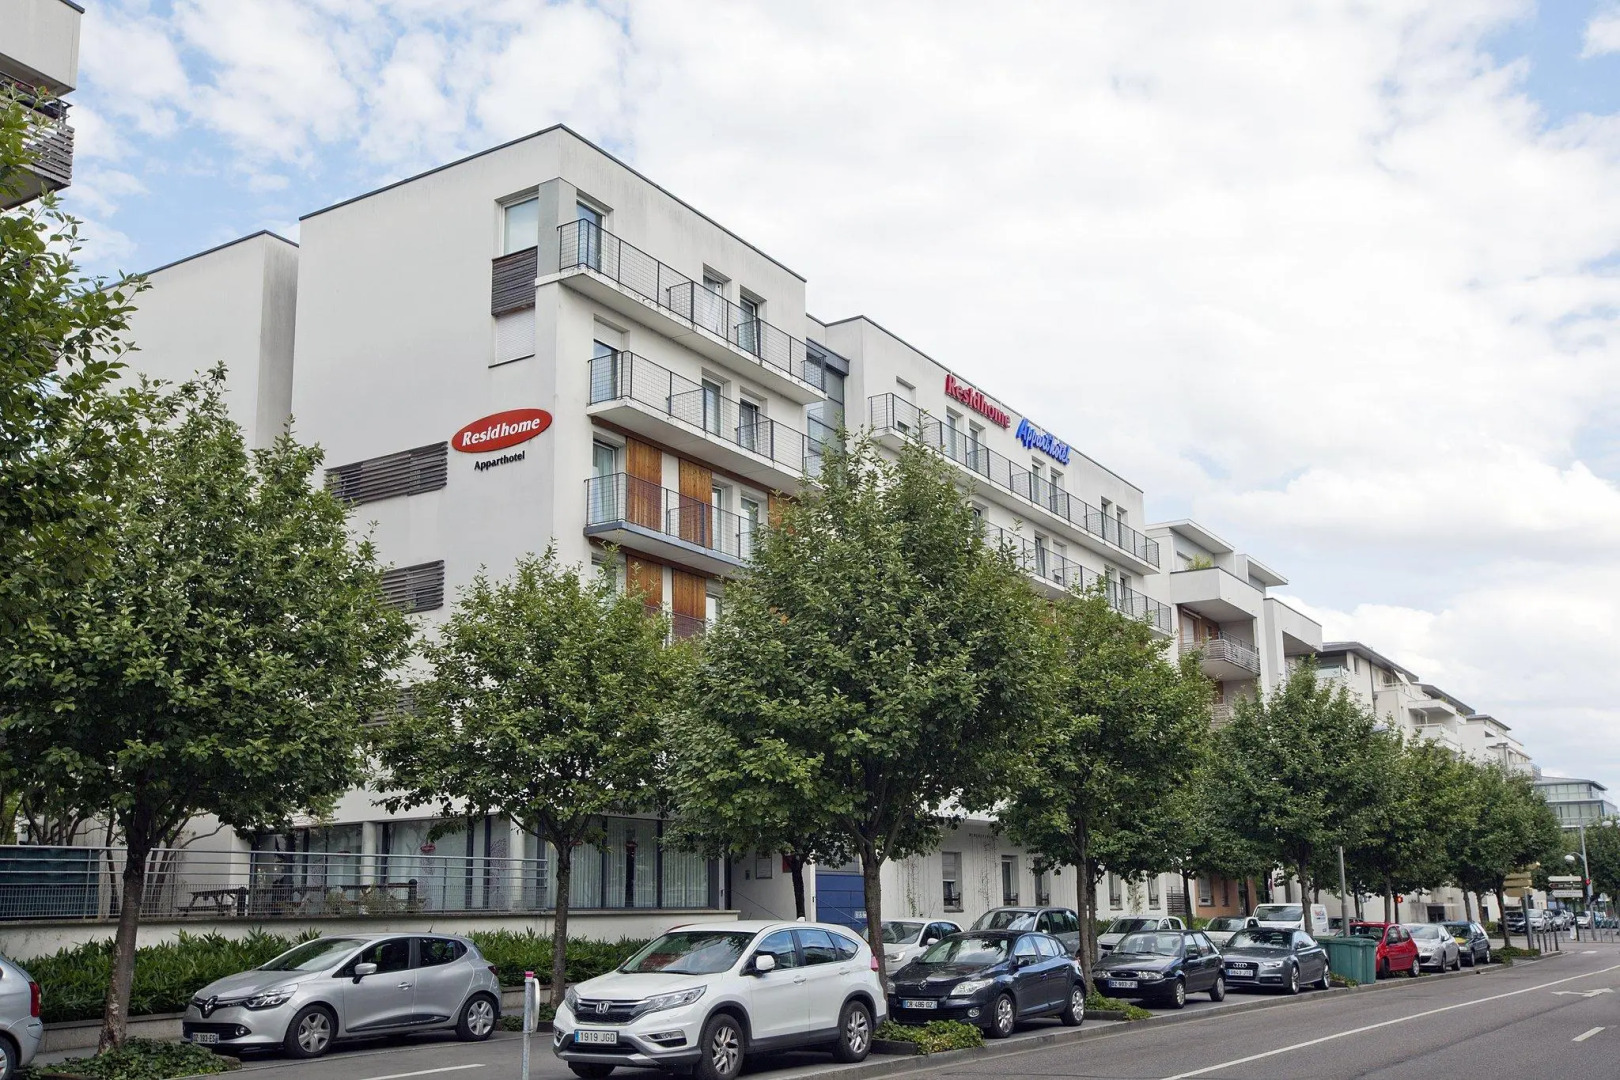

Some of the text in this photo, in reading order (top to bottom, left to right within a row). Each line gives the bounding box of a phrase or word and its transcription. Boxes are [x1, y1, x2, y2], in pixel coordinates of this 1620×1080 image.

[945, 374, 1011, 429] Residhome
[462, 418, 541, 447] Residhome
[474, 450, 526, 472] Apparthotel
[580, 1032, 599, 1042] 1919
